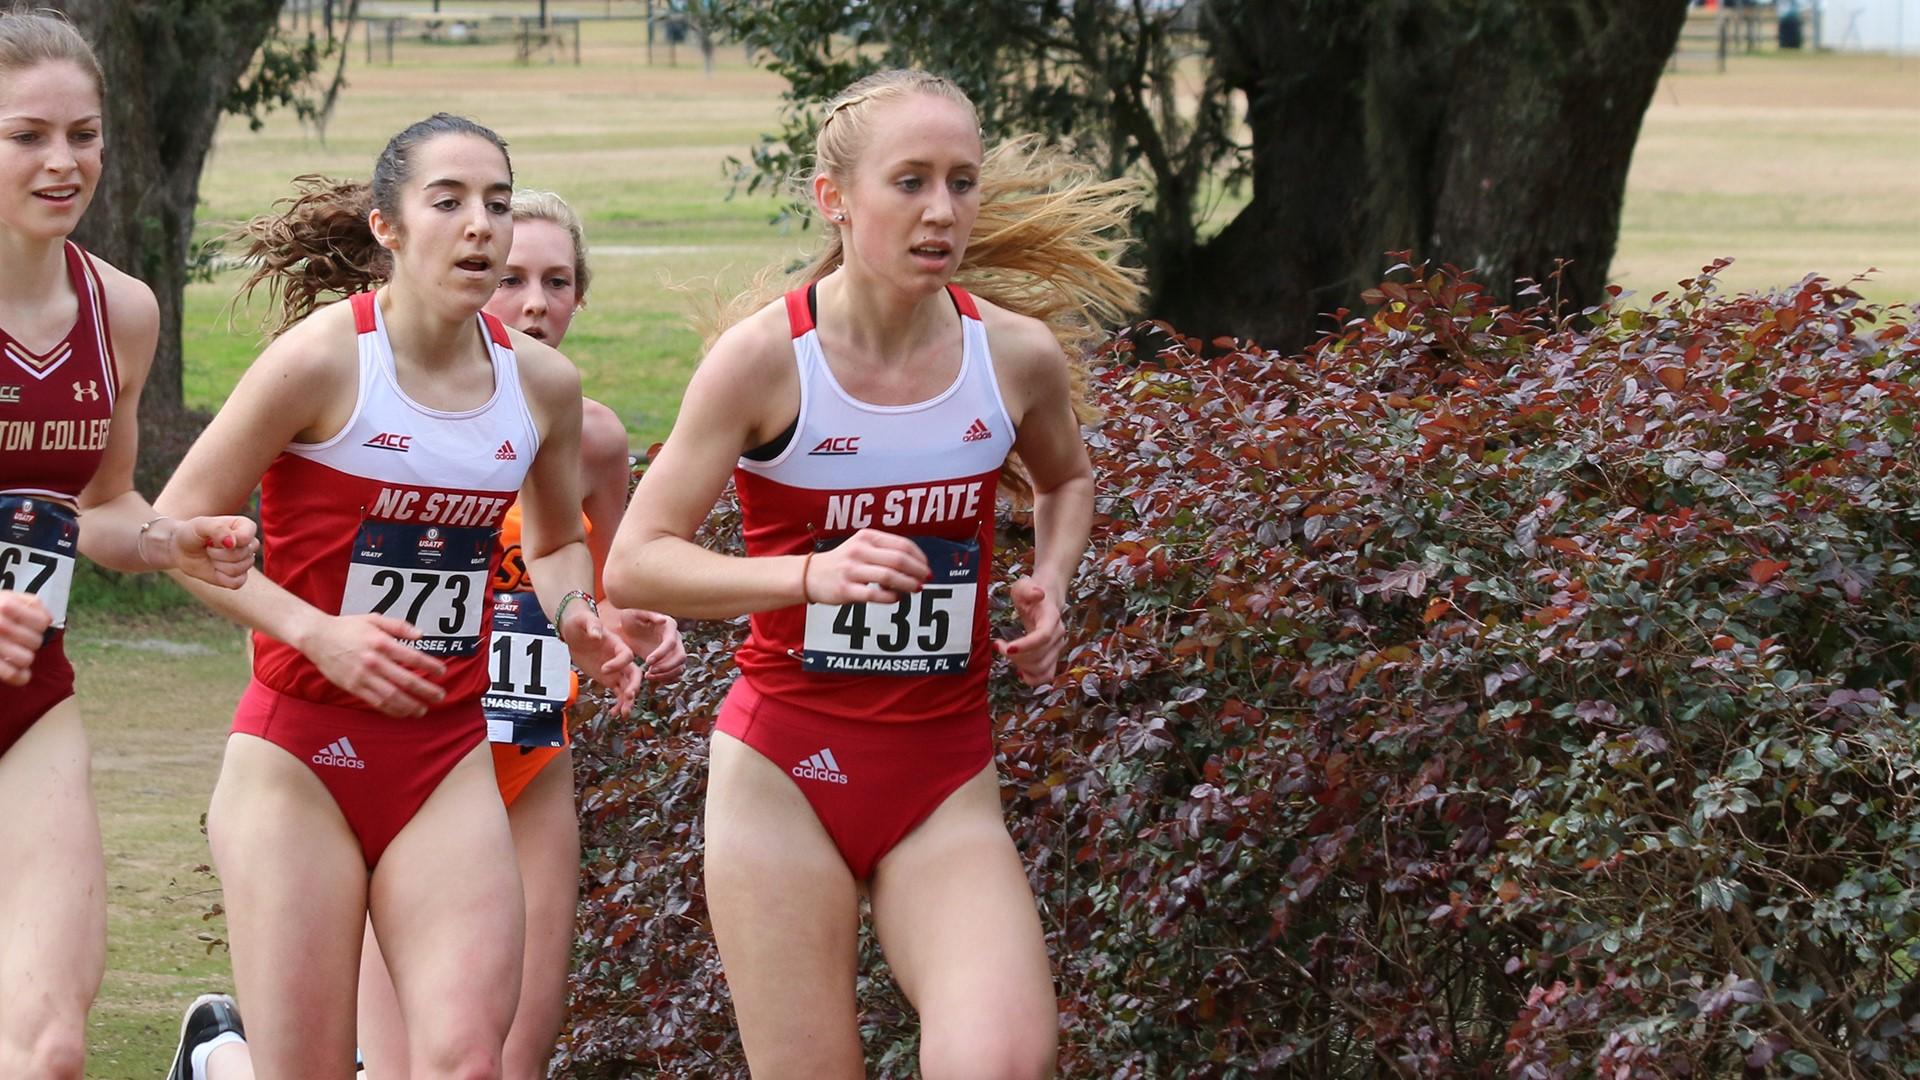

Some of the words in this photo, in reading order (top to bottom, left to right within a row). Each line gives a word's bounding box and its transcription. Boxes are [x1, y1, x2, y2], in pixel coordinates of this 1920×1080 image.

[367, 432, 412, 449] ACC
[812, 436, 861, 452] ACC
[963, 430, 992, 443] adidas
[495, 452, 517, 460] adidas
[370, 487, 421, 521] NC
[418, 492, 508, 527] STATE
[824, 493, 875, 530] NC
[881, 481, 983, 527] STATE
[418, 540, 444, 548] USATF
[361, 550, 383, 558] USATF
[949, 569, 970, 577] USATF
[369, 570, 471, 635] 273
[494, 603, 518, 612] USATF
[832, 588, 953, 652] 435
[393, 638, 447, 653] HASSEE,
[450, 640, 463, 651] FL
[826, 655, 931, 673] TALLAHASSEE,
[934, 658, 950, 670] FL
[540, 702, 553, 713] FL
[312, 754, 365, 769] adidas
[792, 765, 848, 784] adidas
